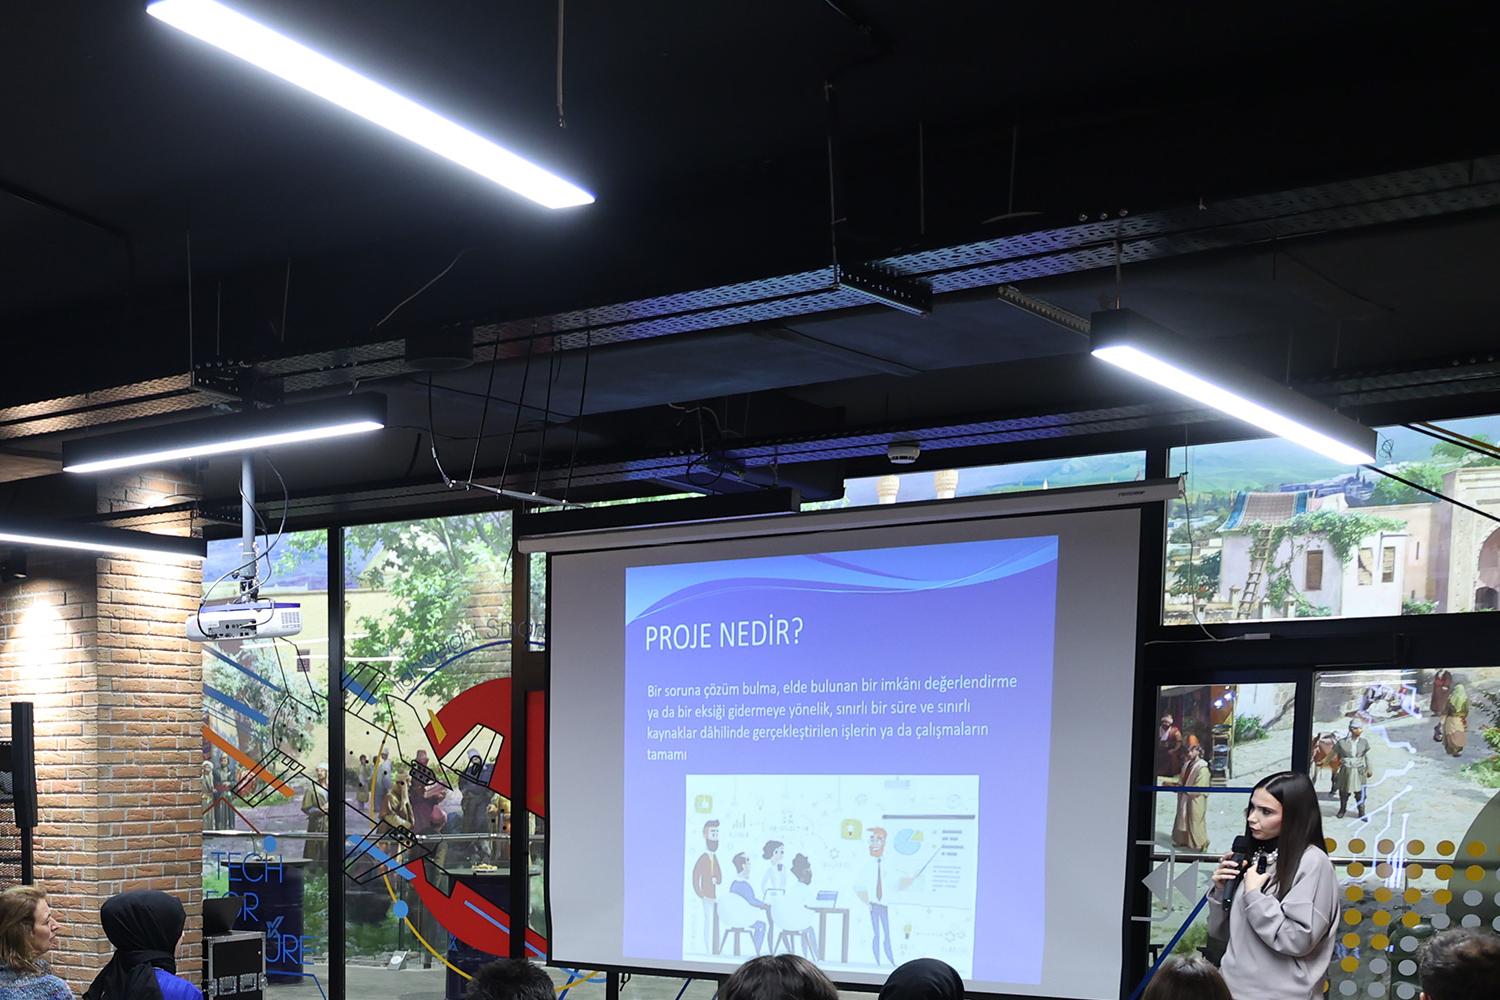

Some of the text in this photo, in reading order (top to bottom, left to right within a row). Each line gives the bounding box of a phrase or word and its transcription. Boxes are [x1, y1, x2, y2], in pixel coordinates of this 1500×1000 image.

[645, 613, 804, 651] PROJE NEDİR?
[647, 673, 1018, 700] Bir soruna çözüm bulma, elde bulunan bir imkânı değerlendirme
[646, 697, 971, 722] ya da bir eksiği gidermeye yönelik, sınırlı bir süre ve sınırlı
[647, 721, 989, 742] kaynaklar dâhilinde gerçekleştirilen işlerin ya da çalışmaların
[646, 748, 687, 761] tamamı
[211, 852, 284, 884] TECH
[265, 933, 315, 965] URE
